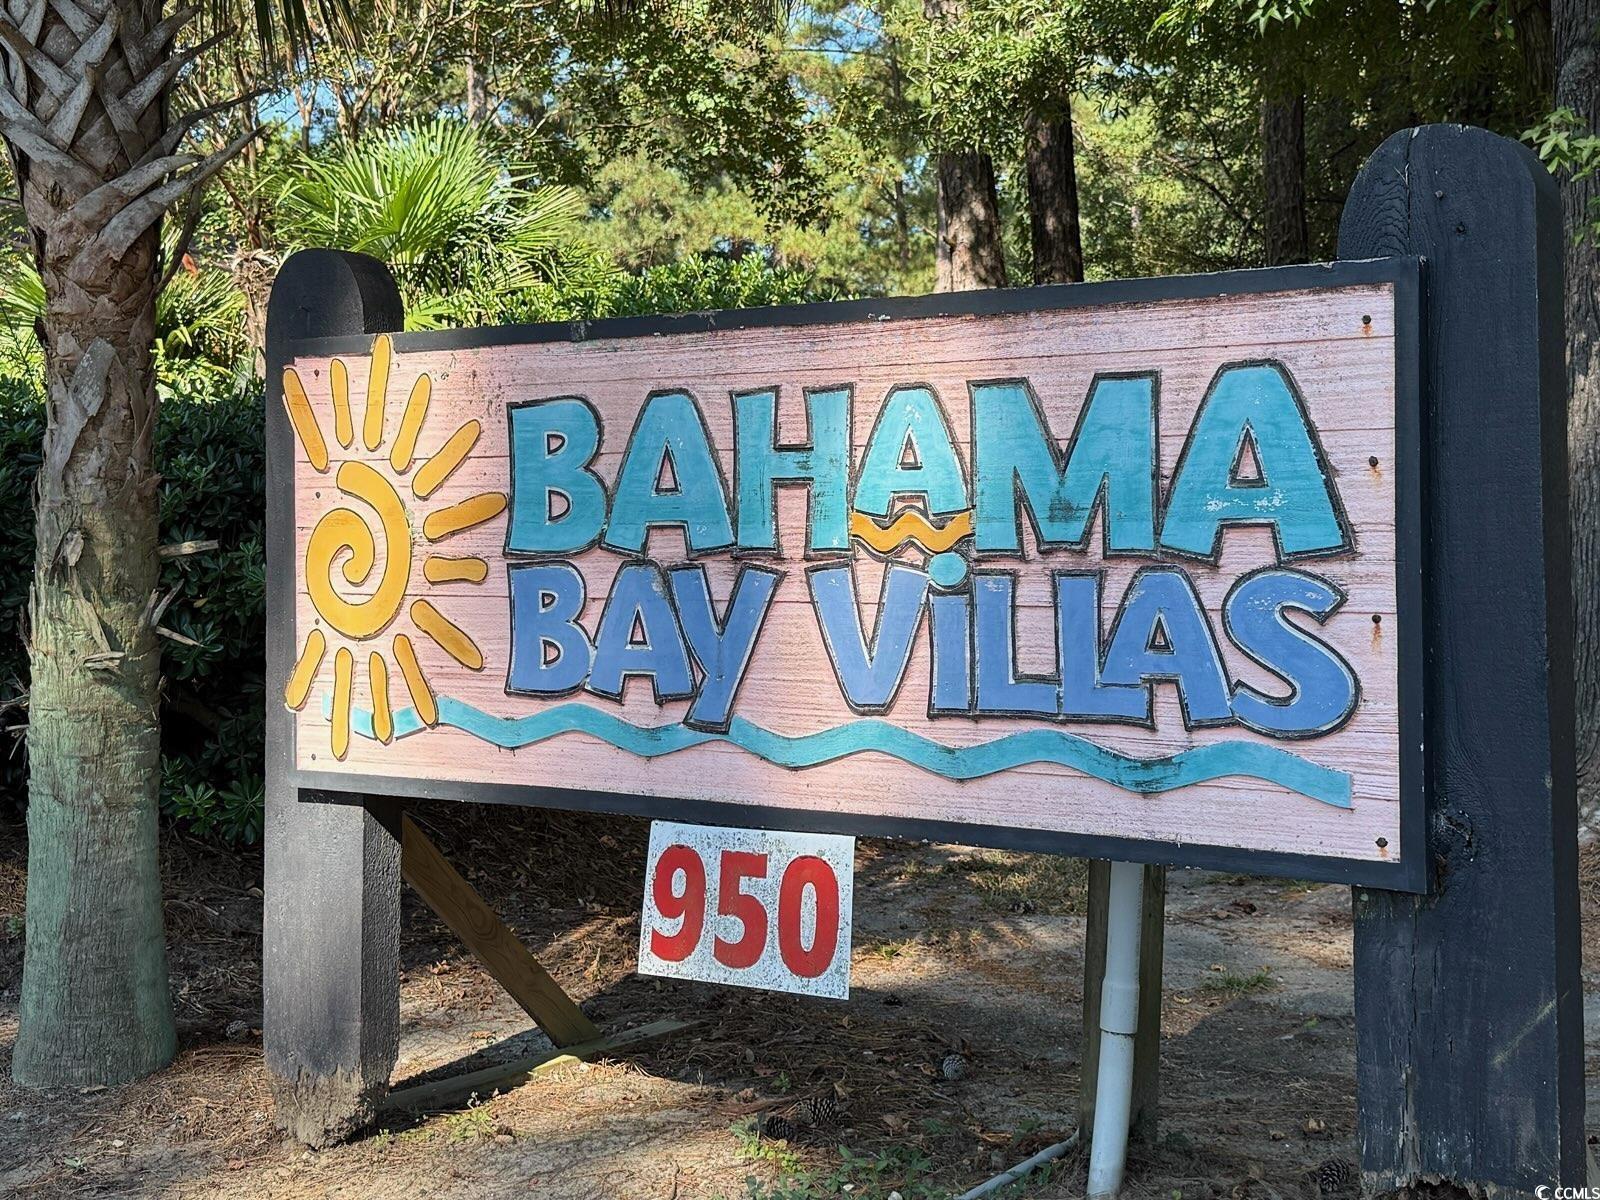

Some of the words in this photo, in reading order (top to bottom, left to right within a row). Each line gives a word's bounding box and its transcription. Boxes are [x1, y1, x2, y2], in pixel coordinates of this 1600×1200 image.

[503, 359, 1357, 566] BAHAMA
[504, 558, 787, 733] BAY
[650, 843, 840, 979] 950
